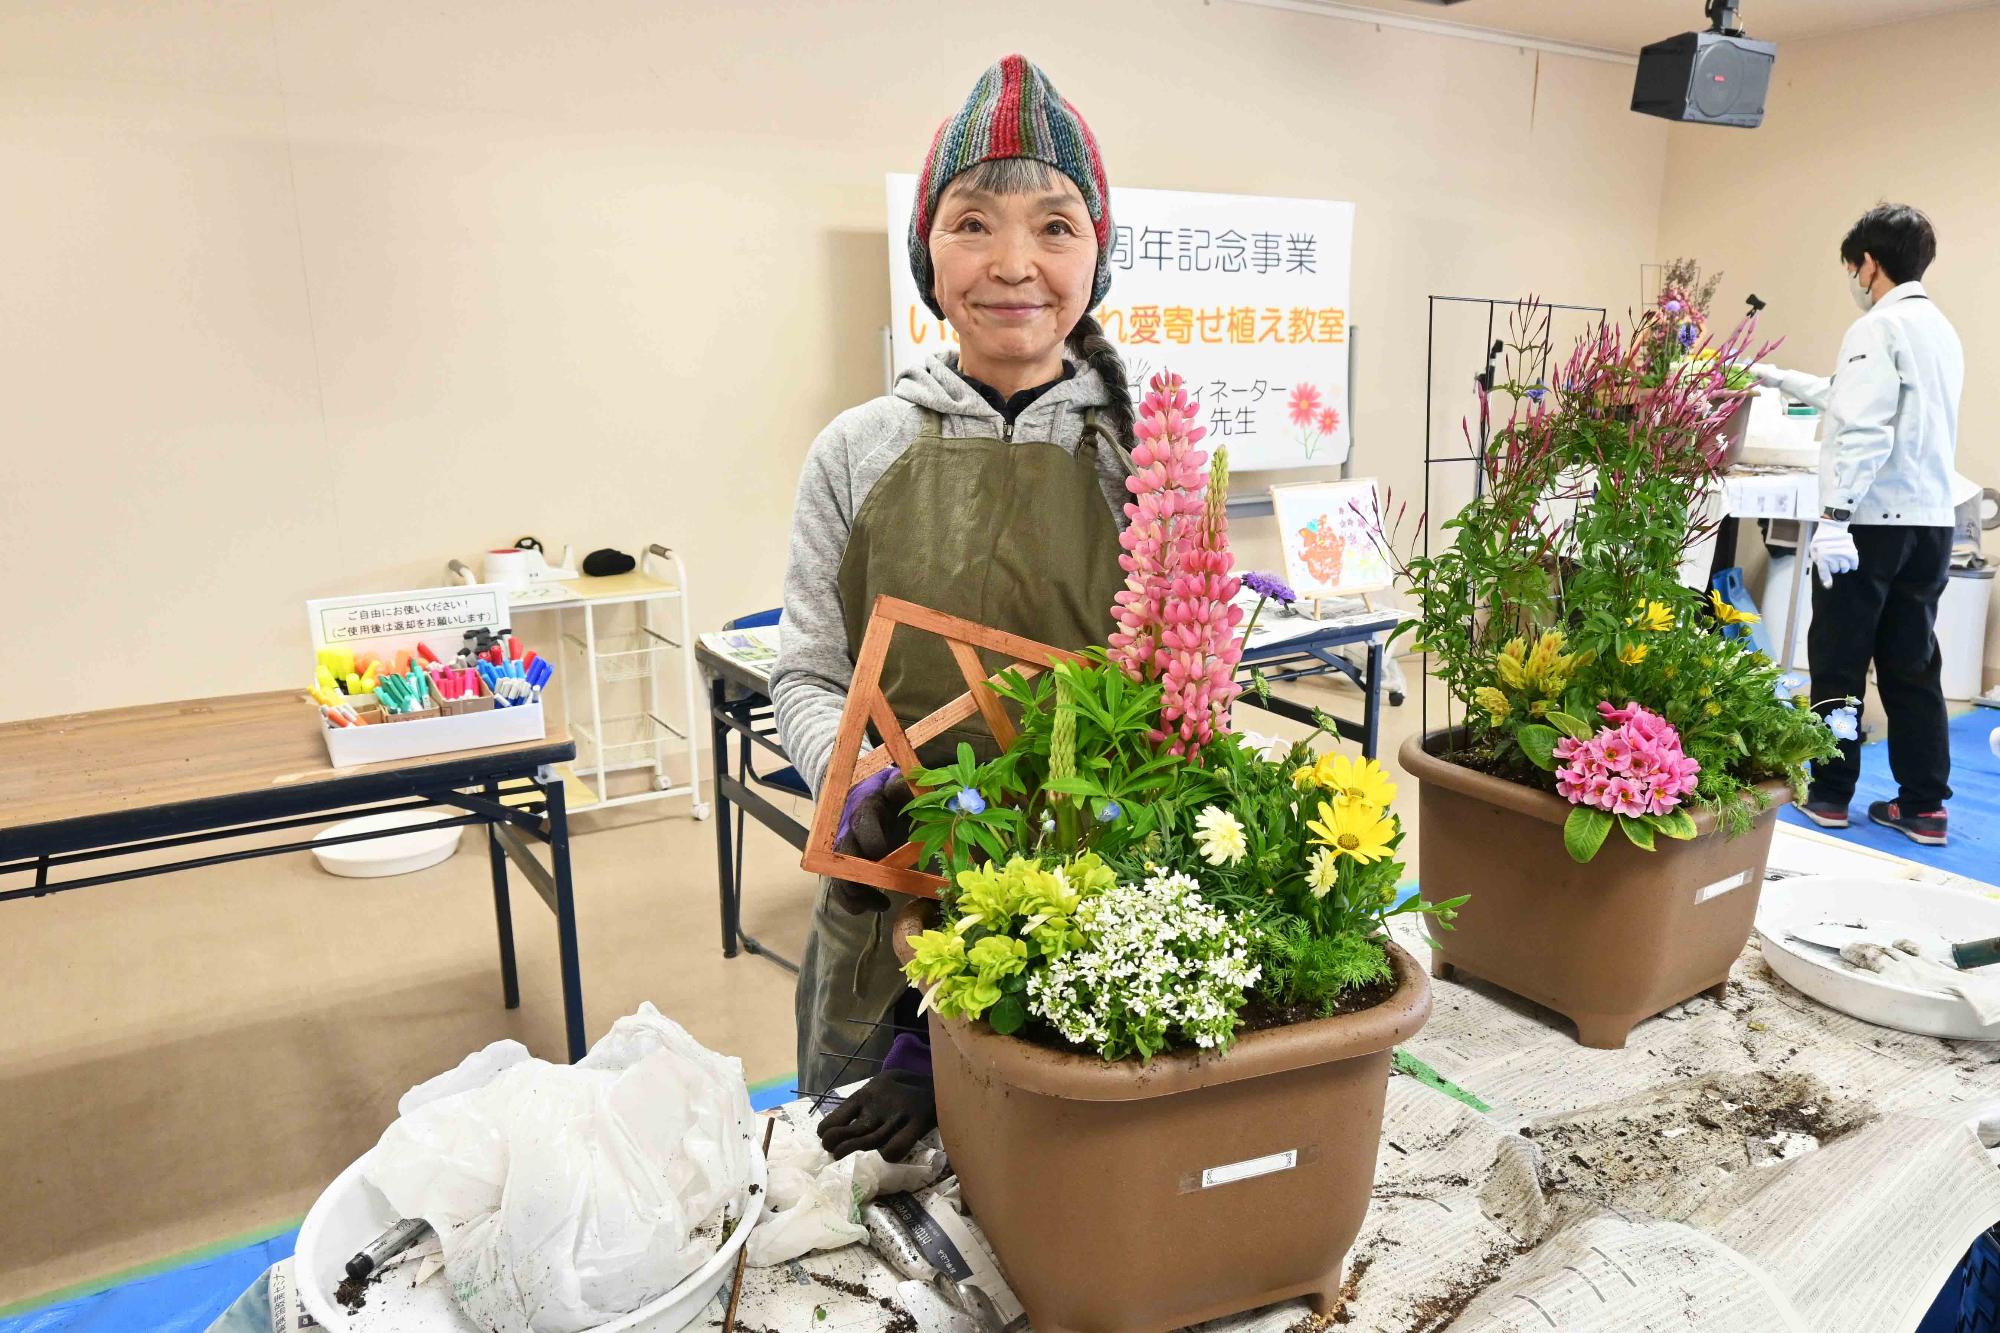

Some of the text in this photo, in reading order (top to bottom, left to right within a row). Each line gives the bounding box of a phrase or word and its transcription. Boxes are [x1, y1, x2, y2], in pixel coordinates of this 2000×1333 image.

[1111, 225, 1317, 275] 周年記念事業
[1210, 406, 1257, 437] 先生
